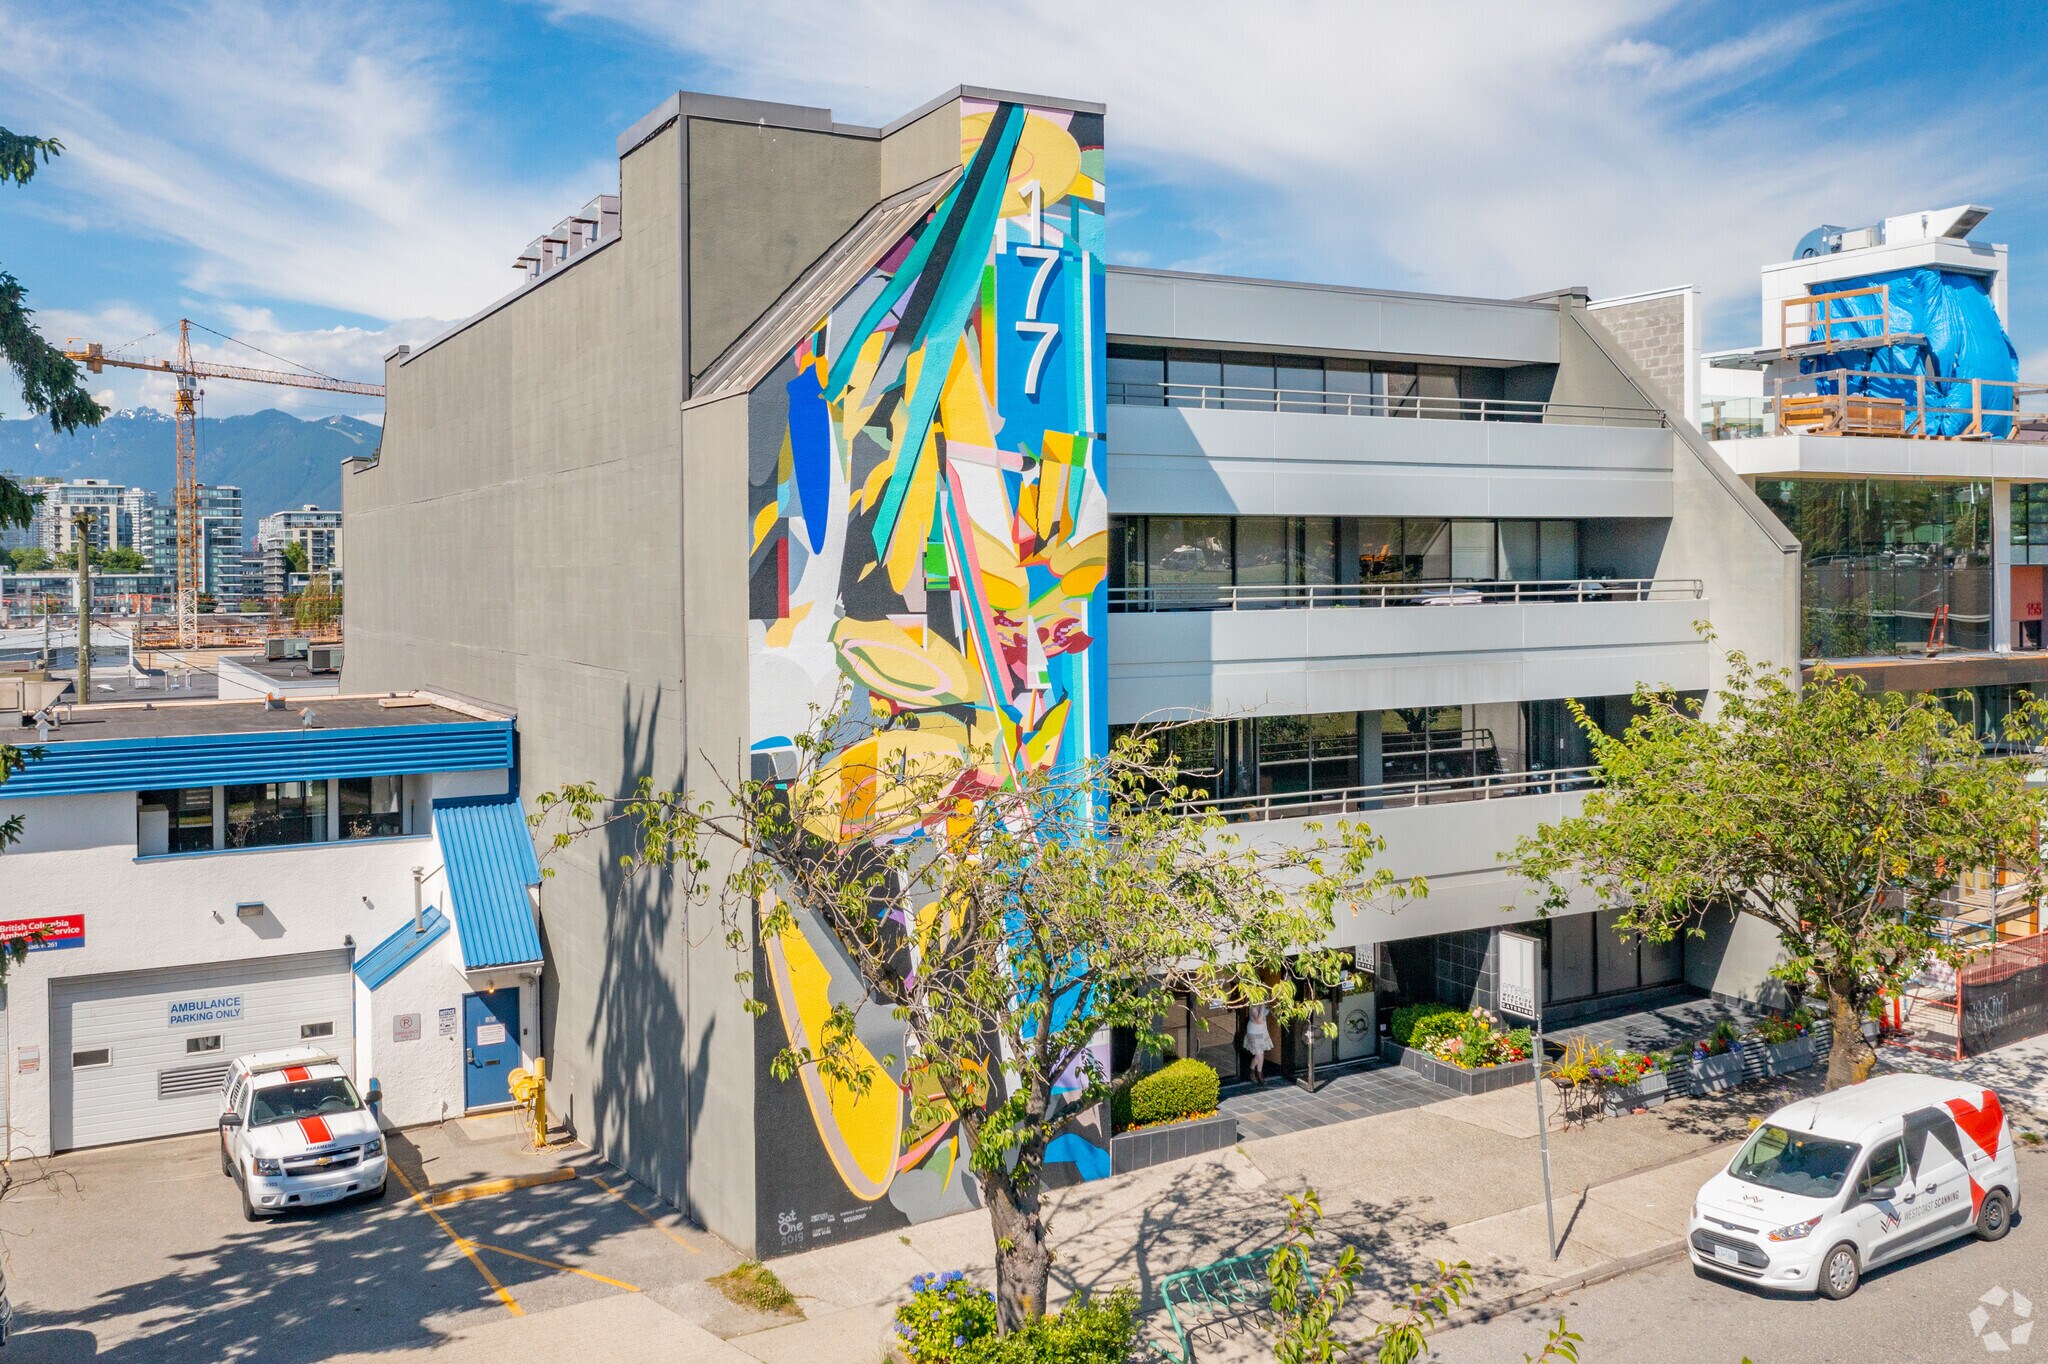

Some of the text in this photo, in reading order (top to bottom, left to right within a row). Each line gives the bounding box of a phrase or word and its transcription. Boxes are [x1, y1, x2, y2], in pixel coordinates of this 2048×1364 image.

[1016, 179, 1060, 394] 177
[0, 924, 27, 933] British
[52, 926, 80, 935] ervice
[170, 997, 241, 1013] AMBULANCE
[1502, 997, 1532, 1009] KITCHEN
[1502, 1002, 1533, 1016] CATERING
[170, 1008, 240, 1024] PARKING ONLY
[306, 1143, 338, 1152] PARAMEDIC
[1904, 1189, 1960, 1221] WESTCOAST SCANNING
[778, 1210, 797, 1224] Sat
[779, 1221, 804, 1236] One
[781, 1232, 804, 1246] 2019
